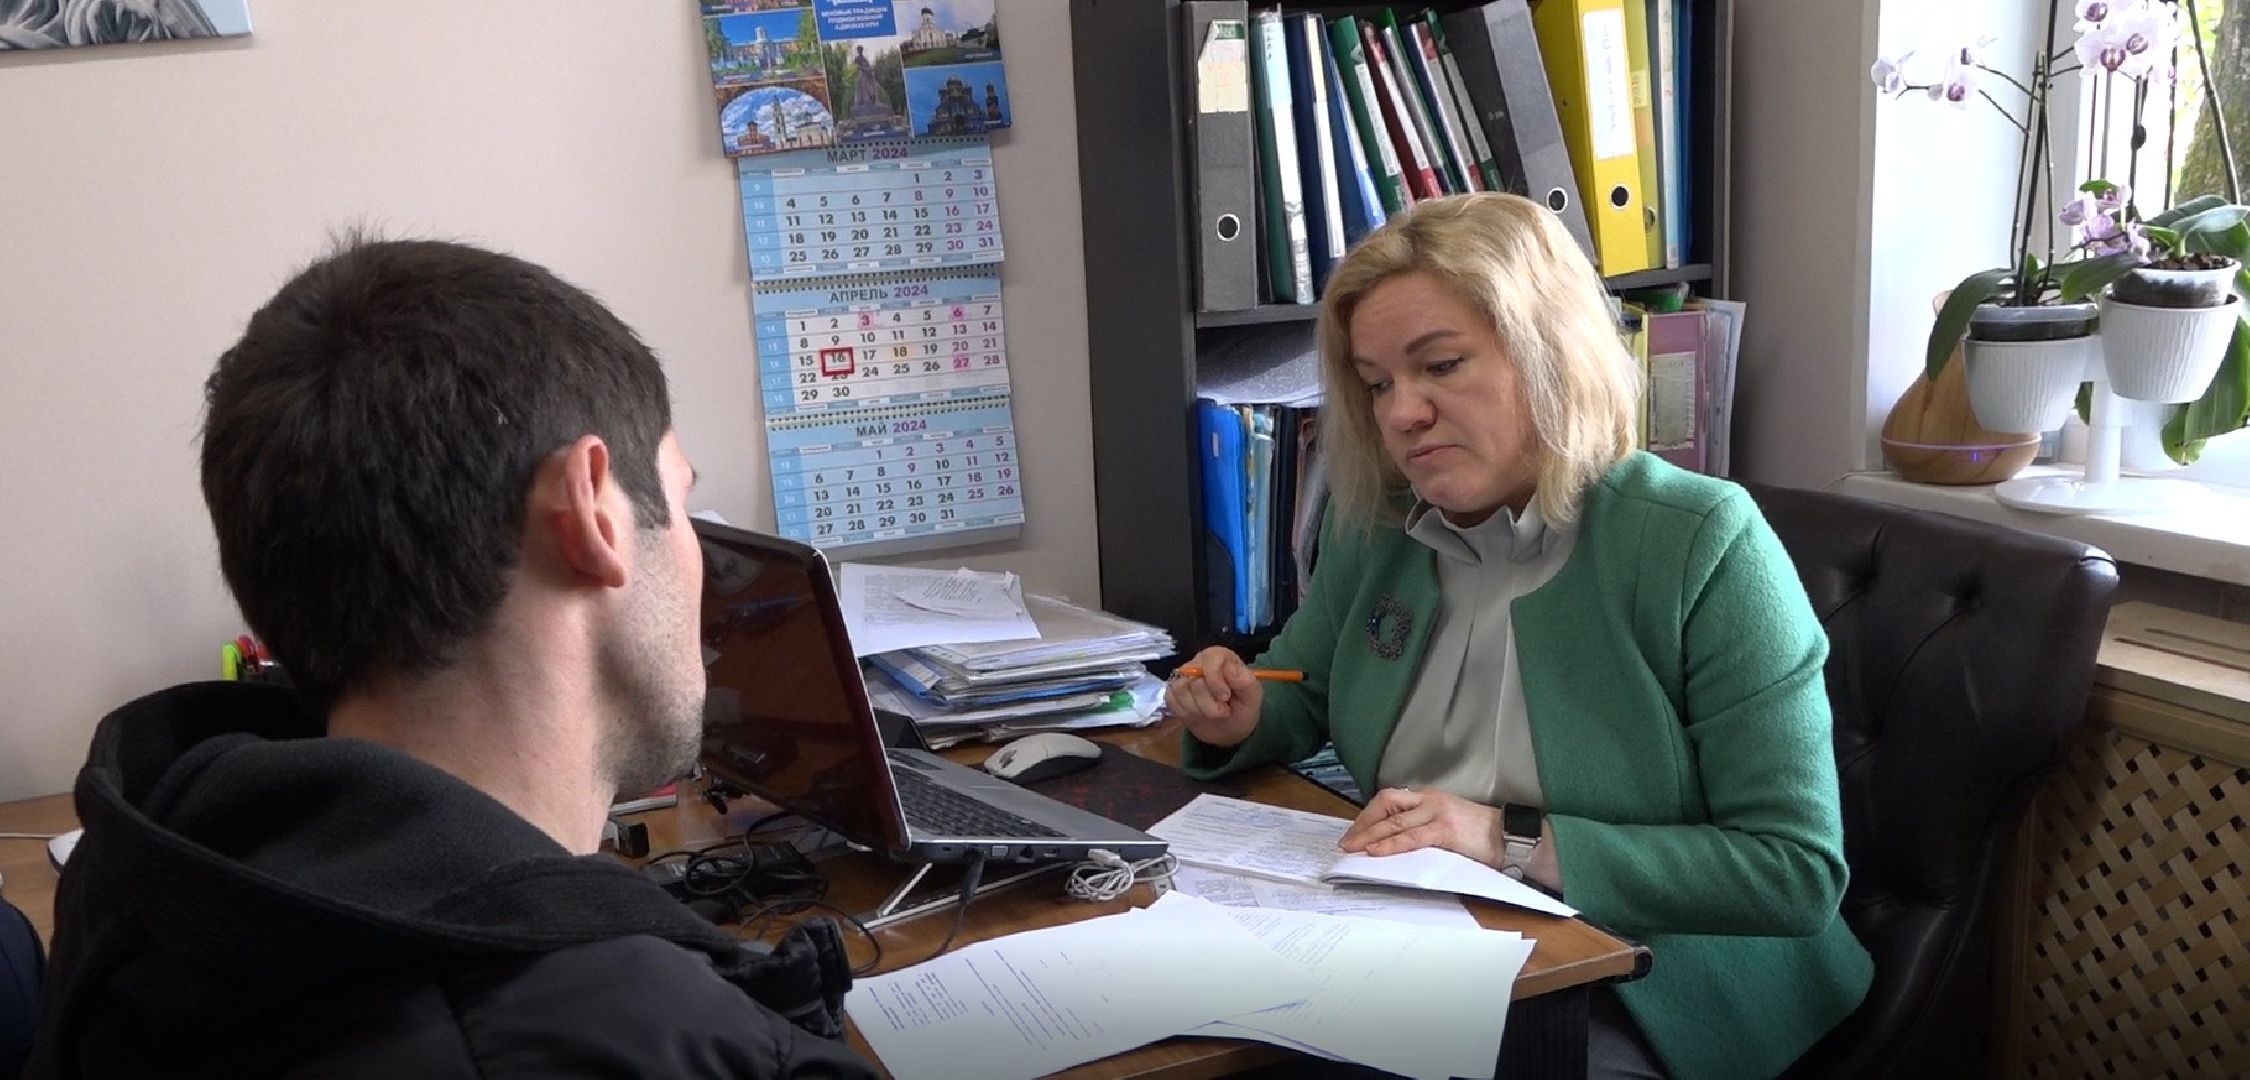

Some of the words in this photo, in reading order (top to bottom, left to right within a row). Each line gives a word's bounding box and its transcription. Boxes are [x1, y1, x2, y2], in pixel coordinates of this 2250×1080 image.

[827, 149, 866, 162] МАРТ
[872, 147, 908, 159] 2024
[914, 173, 920, 183] 1
[944, 170, 952, 181] 2
[974, 169, 983, 180] 3
[786, 198, 796, 209] 4
[820, 196, 828, 207] 5
[852, 194, 860, 205] 6
[883, 191, 890, 202] 7
[914, 190, 923, 201] 8
[945, 188, 954, 199] 9
[973, 187, 989, 197] 10
[786, 215, 800, 226] 11
[818, 214, 834, 225] 12
[851, 211, 866, 222] 13
[883, 210, 897, 220] 14
[914, 207, 928, 218] 15
[945, 205, 959, 216] 16
[975, 203, 989, 214] 17
[789, 233, 805, 244] 18
[821, 231, 836, 242] 19
[851, 229, 869, 241] 20
[883, 227, 898, 237] 21
[914, 225, 931, 236] 22
[945, 222, 962, 233] 23
[976, 221, 993, 231] 24
[789, 251, 807, 262] 25
[821, 249, 839, 259] 26
[853, 246, 870, 257] 27
[885, 244, 902, 256] 28
[916, 242, 933, 253] 29
[947, 240, 964, 251] 30
[979, 237, 994, 247] 31
[829, 288, 888, 303] АПРЕЛЬ
[894, 284, 928, 298] 2024
[800, 320, 806, 331] 1
[830, 318, 838, 329] 2
[861, 315, 870, 326] 3
[893, 312, 901, 322] 4
[922, 310, 931, 321] 5
[953, 308, 962, 317] 6
[983, 305, 992, 315] 7
[800, 338, 808, 349] 8
[831, 335, 840, 346] 9
[860, 332, 875, 343] 10
[893, 330, 904, 340] 11
[922, 327, 937, 337] 12
[953, 324, 967, 335] 13
[983, 321, 996, 332] 14
[799, 355, 814, 366] 15
[831, 351, 846, 363] 16
[862, 350, 876, 361] 17
[893, 346, 907, 357] 18
[923, 343, 938, 354] 19
[952, 341, 969, 352] 20
[983, 338, 996, 349] 21
[799, 372, 817, 383] 22
[862, 367, 879, 378] 24
[893, 363, 910, 374] 25
[923, 361, 940, 372] 26
[953, 357, 969, 369] 27
[983, 355, 1000, 365] 28
[801, 389, 818, 400] 29
[833, 386, 849, 398] 30
[857, 421, 887, 436] МАЙ
[893, 420, 927, 432] 2024
[876, 450, 881, 460] 1
[906, 446, 914, 456] 2
[936, 442, 944, 453] 3
[966, 440, 974, 449] 4
[995, 436, 1004, 446] 5
[815, 473, 823, 484] 6
[846, 470, 854, 480] 7
[877, 466, 885, 477] 8
[908, 462, 916, 473] 9
[936, 459, 950, 470] 10
[966, 456, 978, 466] 11
[995, 452, 1009, 462] 12
[814, 490, 829, 501] 13
[846, 486, 860, 497] 14
[876, 483, 891, 493] 15
[907, 480, 922, 490] 16
[937, 476, 952, 486] 17
[967, 472, 982, 482] 18
[998, 468, 1011, 478] 19
[815, 507, 832, 518] 20
[846, 503, 861, 514] 21
[876, 499, 894, 510] 22
[907, 496, 924, 507] 23
[937, 492, 954, 503] 24
[968, 488, 984, 499] 25
[998, 485, 1014, 496] 26
[817, 524, 833, 535] 27
[848, 520, 865, 531] 28
[879, 516, 896, 527] 29
[909, 513, 926, 523] 30
[940, 509, 954, 519] 31
